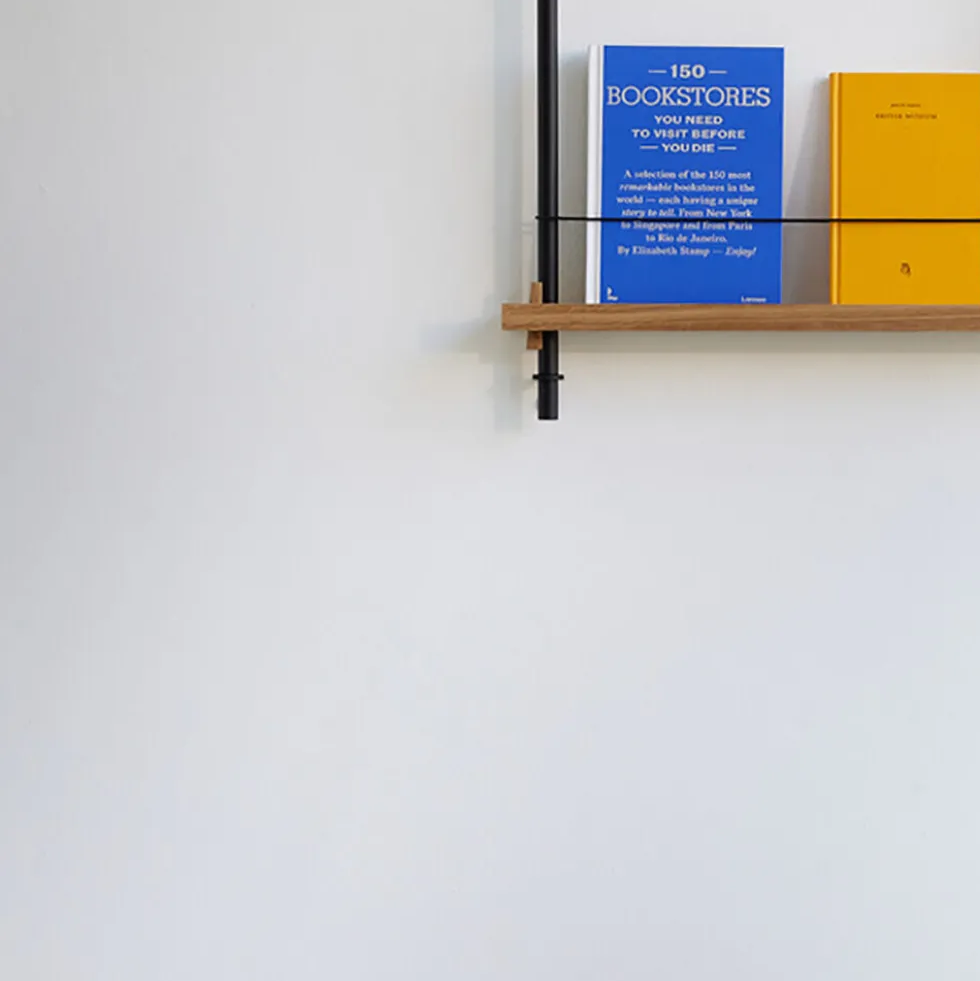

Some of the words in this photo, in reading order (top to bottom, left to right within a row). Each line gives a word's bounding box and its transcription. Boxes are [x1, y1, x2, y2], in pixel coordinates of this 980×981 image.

[670, 64, 705, 79] 150
[606, 86, 771, 107] BOOKSTORES
[654, 115, 682, 125] YOU
[685, 115, 723, 125] NEED
[632, 129, 650, 139] TO
[654, 129, 688, 139] VISIT
[691, 129, 745, 139] BEFORE
[662, 143, 690, 153] YOU
[692, 143, 714, 153] DIE
[624, 170, 633, 179] A
[635, 170, 676, 179] selection
[678, 170, 690, 179] of
[690, 170, 706, 179] the
[709, 170, 725, 180] 150
[728, 172, 751, 180] most
[619, 182, 672, 191] remarkable
[674, 183, 724, 192] bookstores
[727, 183, 737, 192] in
[739, 183, 755, 192] the
[616, 195, 643, 204] world
[658, 196, 681, 204] each
[683, 196, 716, 206] having
[726, 198, 758, 207] unique
[622, 208, 645, 218] story
[648, 209, 657, 217] to
[678, 209, 704, 217] From
[706, 209, 728, 217] New
[730, 209, 752, 218] York
[633, 222, 680, 231] Singapore
[683, 222, 700, 230] and
[702, 222, 726, 230] from
[728, 222, 753, 230] Paris
[646, 234, 655, 242] to
[658, 234, 674, 242] Rio
[676, 234, 687, 242] de
[617, 246, 630, 256] By
[632, 246, 678, 255] Elizabeth
[680, 246, 710, 257] Stamp
[725, 246, 757, 257] Enjoy!
